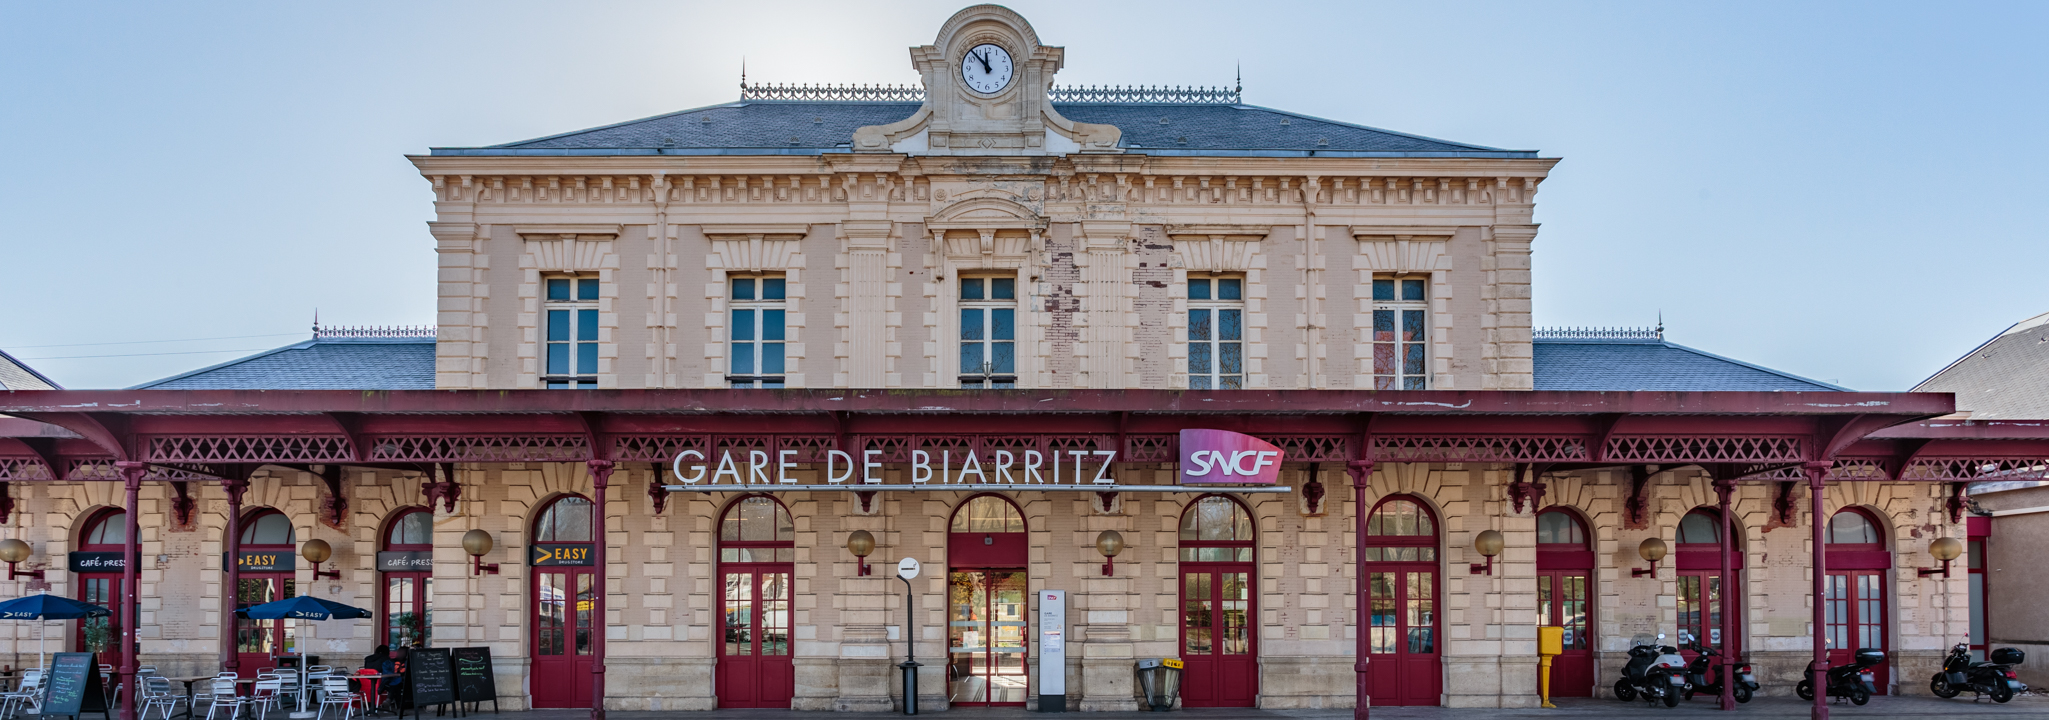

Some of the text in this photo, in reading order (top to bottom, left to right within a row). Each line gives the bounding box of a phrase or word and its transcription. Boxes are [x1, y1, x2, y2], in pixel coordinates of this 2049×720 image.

[673, 449, 1117, 484] GARE DE BIARRITZ
[1186, 450, 1278, 477] SNCF
[246, 555, 276, 566] EASY
[555, 548, 588, 560] EASY
